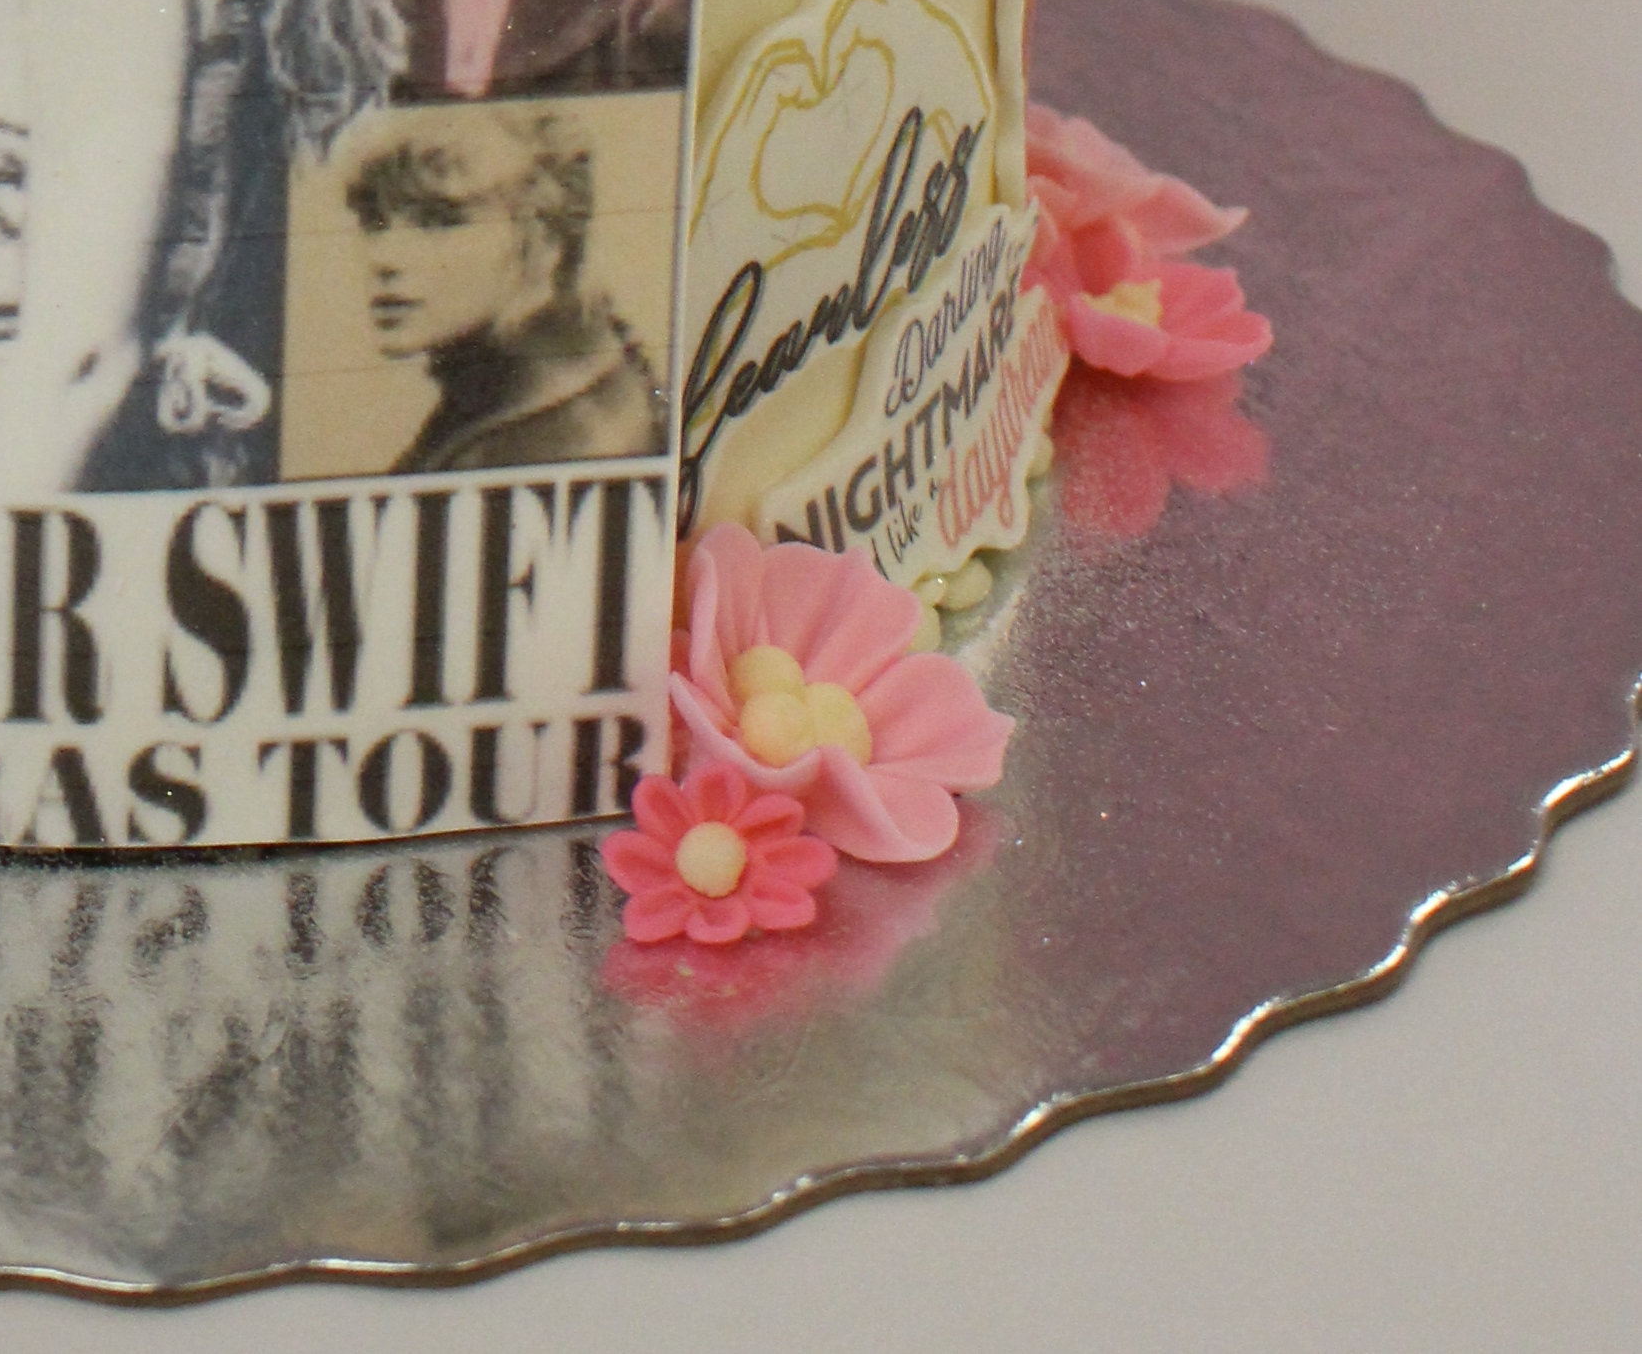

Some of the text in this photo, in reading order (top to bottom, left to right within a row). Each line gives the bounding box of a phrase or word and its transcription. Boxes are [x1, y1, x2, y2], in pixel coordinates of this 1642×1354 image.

[884, 215, 1008, 419] Darling
[161, 475, 670, 726] SWIFT
[257, 712, 650, 843] TOUR
